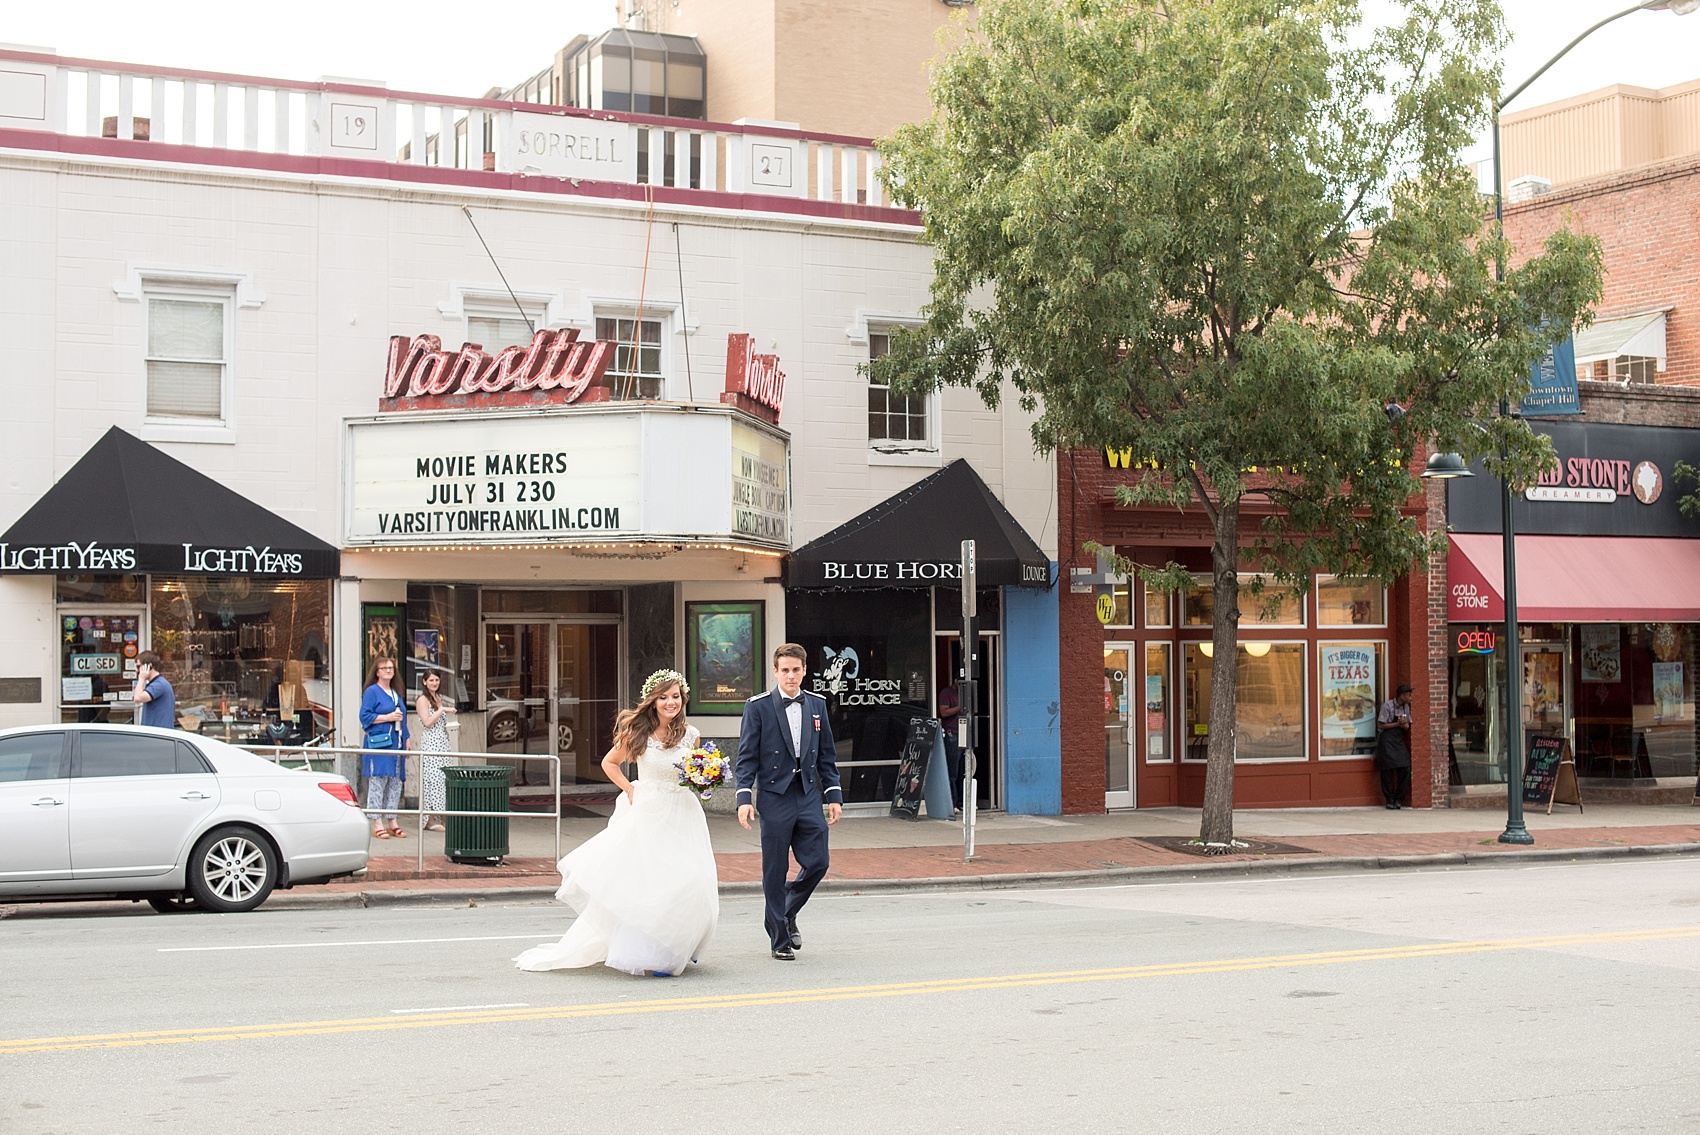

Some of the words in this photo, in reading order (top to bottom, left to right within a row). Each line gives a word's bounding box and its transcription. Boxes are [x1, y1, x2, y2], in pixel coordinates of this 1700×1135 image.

[345, 115, 366, 136] 19
[518, 130, 623, 163] SORRELL
[761, 155, 783, 175] 27
[384, 328, 618, 403] Varsity
[1530, 386, 1573, 395] owntown
[1523, 394, 1555, 407] Chapel
[1558, 394, 1576, 404] Hill
[416, 456, 475, 478] MOVIE
[485, 452, 567, 476] MAKERS
[1566, 457, 1631, 496] STONE
[426, 483, 476, 505] JULY
[486, 481, 504, 503] 31
[516, 480, 556, 502] 230
[1530, 489, 1612, 499] CREAMERY
[378, 507, 620, 533] VARSITYONFRANKLIN.COM
[823, 562, 889, 579] BLUE
[1022, 564, 1047, 582] LOUNGE
[1452, 584, 1477, 596] COLD
[1456, 595, 1489, 608] STONE
[1457, 631, 1496, 649] OPEN
[77, 658, 115, 670] CLSED
[1340, 650, 1361, 661] BIGGER
[1360, 653, 1370, 664] ON
[1328, 665, 1370, 680] TEXAS
[855, 679, 901, 691] HORN
[839, 693, 901, 706] LOUNGE
